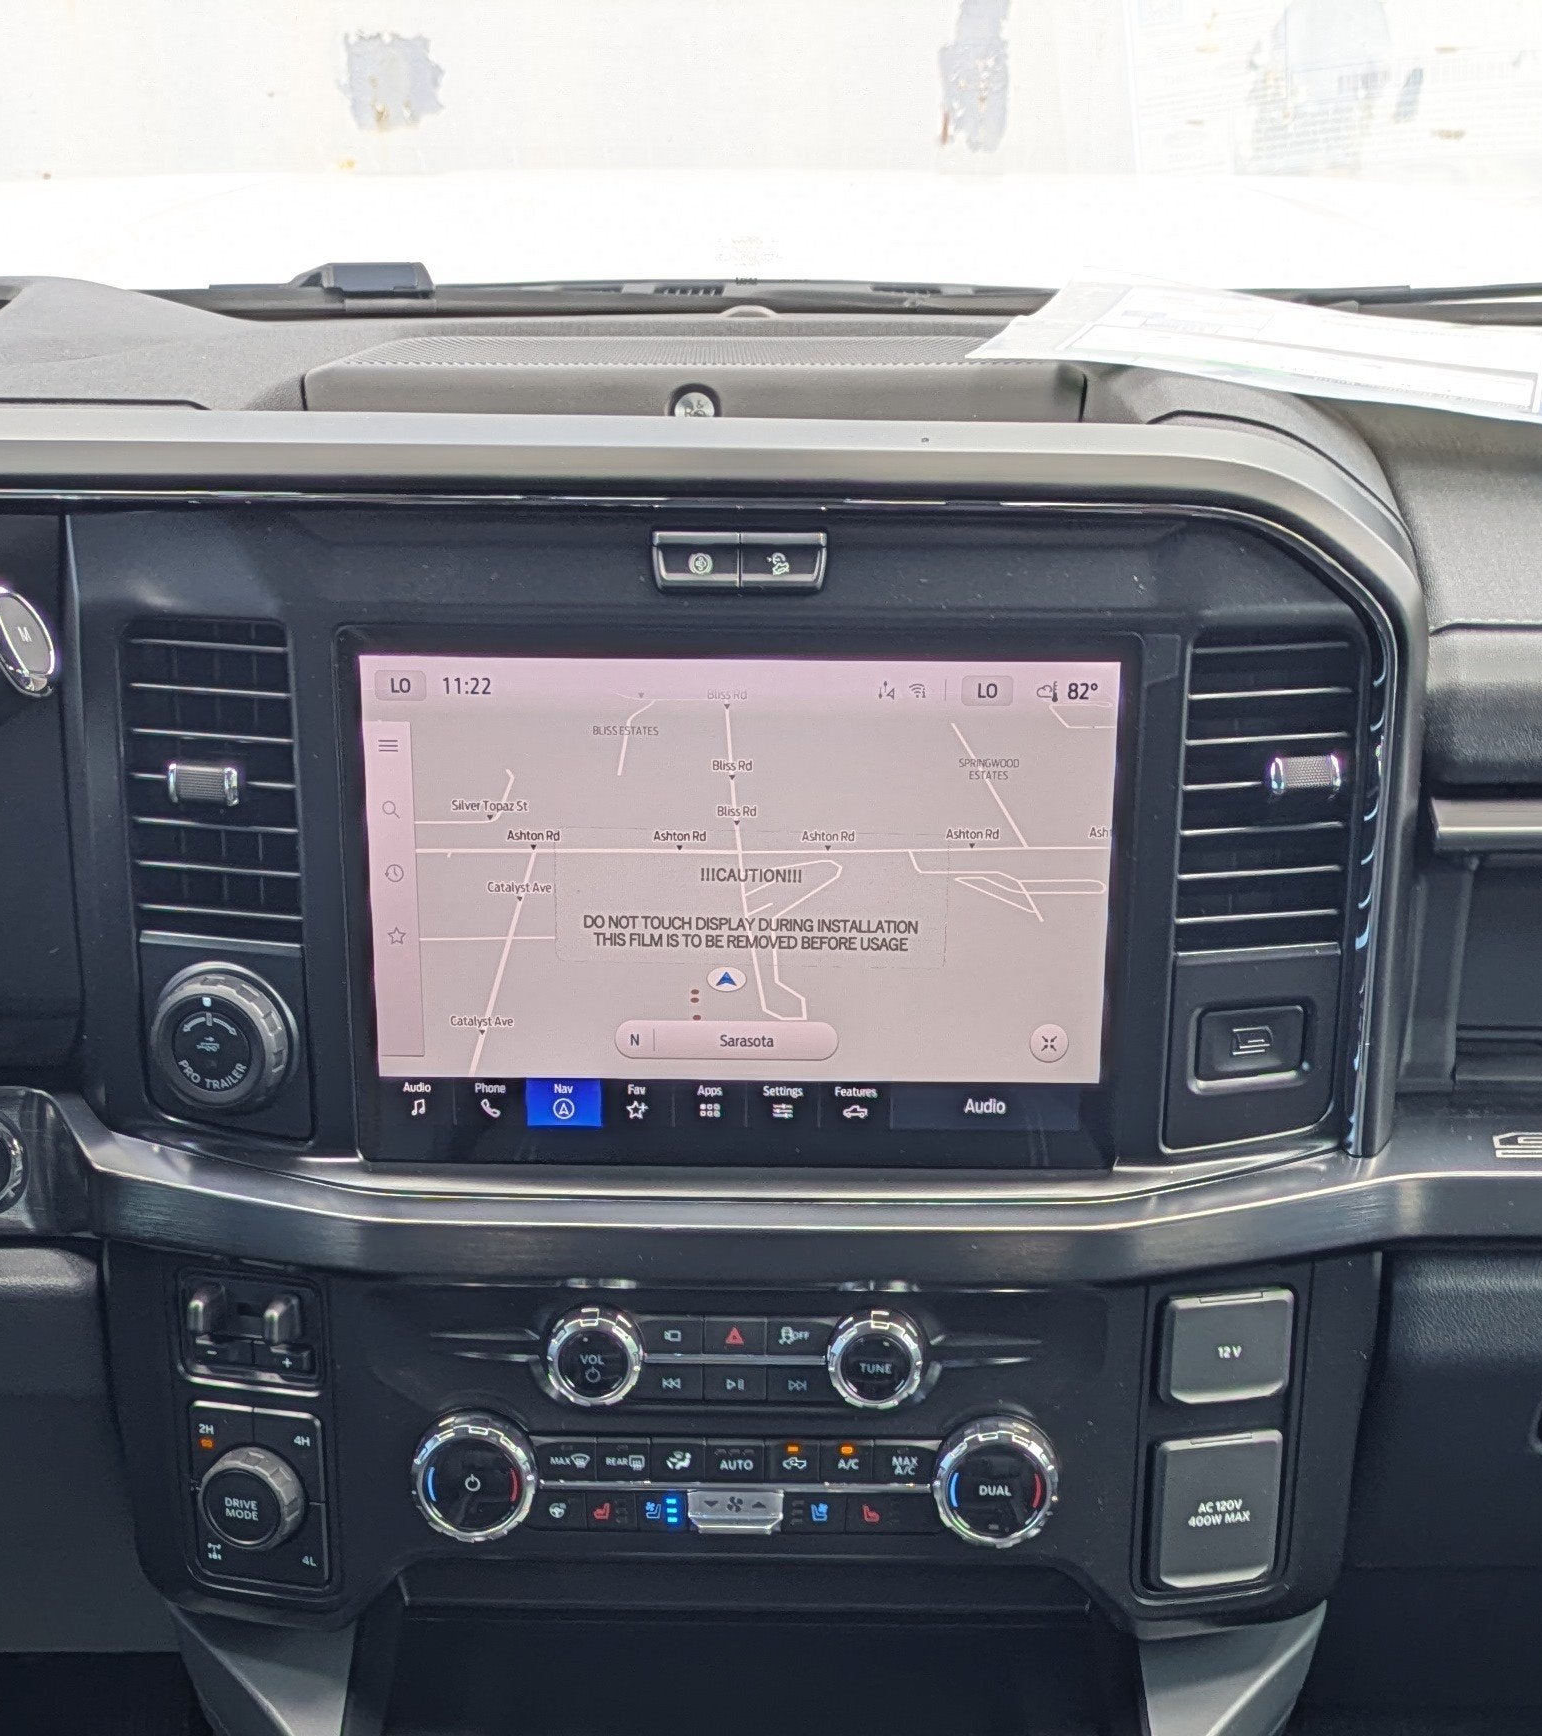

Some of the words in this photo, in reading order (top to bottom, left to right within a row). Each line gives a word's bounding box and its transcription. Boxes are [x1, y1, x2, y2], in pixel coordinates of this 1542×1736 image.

[390, 677, 411, 694] LO
[442, 677, 492, 695] 11:22
[976, 683, 998, 699] LO
[1067, 682, 1099, 700] 82°
[592, 726, 617, 736] BLISS
[619, 726, 659, 736] ESTATES
[711, 760, 736, 772] Bliss
[738, 760, 753, 772] Rd
[958, 758, 1020, 768] SPRINGWOOD
[968, 771, 1009, 781] ESTATES
[451, 800, 480, 812] Silver
[482, 800, 515, 814] Topaz
[516, 800, 528, 812] St
[716, 806, 741, 817] Bliss
[743, 806, 757, 817] Rd
[506, 830, 543, 842] Ashton
[545, 830, 560, 842] Rd
[653, 831, 691, 842] Ashton
[692, 831, 707, 842] Rd
[801, 831, 837, 842] Ashton
[839, 831, 855, 842] Rd
[945, 829, 981, 840] Ashton
[983, 829, 1000, 840] Rd
[486, 881, 529, 896] Catalyst
[531, 881, 552, 894] Ave
[583, 915, 605, 929] DO
[608, 915, 639, 930] NOT
[641, 916, 691, 931] TOUCH
[695, 917, 756, 932] DISPLAY
[758, 919, 814, 933] DURING
[817, 920, 919, 934] INSTALLATION
[594, 932, 627, 947] THIS
[629, 932, 664, 948] FILM
[666, 933, 680, 948] IS
[681, 933, 703, 948] TO
[705, 934, 724, 948] BE
[727, 935, 798, 950] REMOVED
[800, 936, 858, 950] BEFORE
[860, 937, 909, 952] USAGE
[450, 1015, 491, 1028] Catalyst
[493, 1015, 514, 1027] Ave
[629, 1033, 640, 1046] N
[719, 1034, 774, 1048] Sarasota
[177, 1059, 201, 1084] PRO
[204, 1062, 248, 1090] TRAILER
[402, 1082, 431, 1093] Audio
[474, 1082, 506, 1094] Phone
[554, 1083, 574, 1094] Nav
[627, 1084, 646, 1095] Fav
[697, 1085, 723, 1098] Apps
[762, 1085, 804, 1098] Settings
[834, 1086, 878, 1098] Features
[963, 1098, 1006, 1114] Audio
[579, 1355, 605, 1366] VOL
[859, 1363, 892, 1375] TUNE
[198, 1424, 215, 1435] 2H
[293, 1435, 310, 1447] 4H
[549, 1456, 571, 1466] MAX
[605, 1456, 629, 1467] REAR
[719, 1459, 754, 1471] AUTO
[837, 1458, 859, 1471] A/C
[892, 1456, 918, 1467] MAX
[894, 1465, 917, 1477] A/C
[978, 1484, 1012, 1496] DUAL
[224, 1498, 258, 1511] DRIVE
[1197, 1501, 1213, 1513] AC
[1215, 1499, 1242, 1512] 120V
[224, 1508, 258, 1521] MODE
[1187, 1513, 1221, 1527] 400W
[1224, 1510, 1250, 1524] MAX
[301, 1555, 317, 1567] 4L
